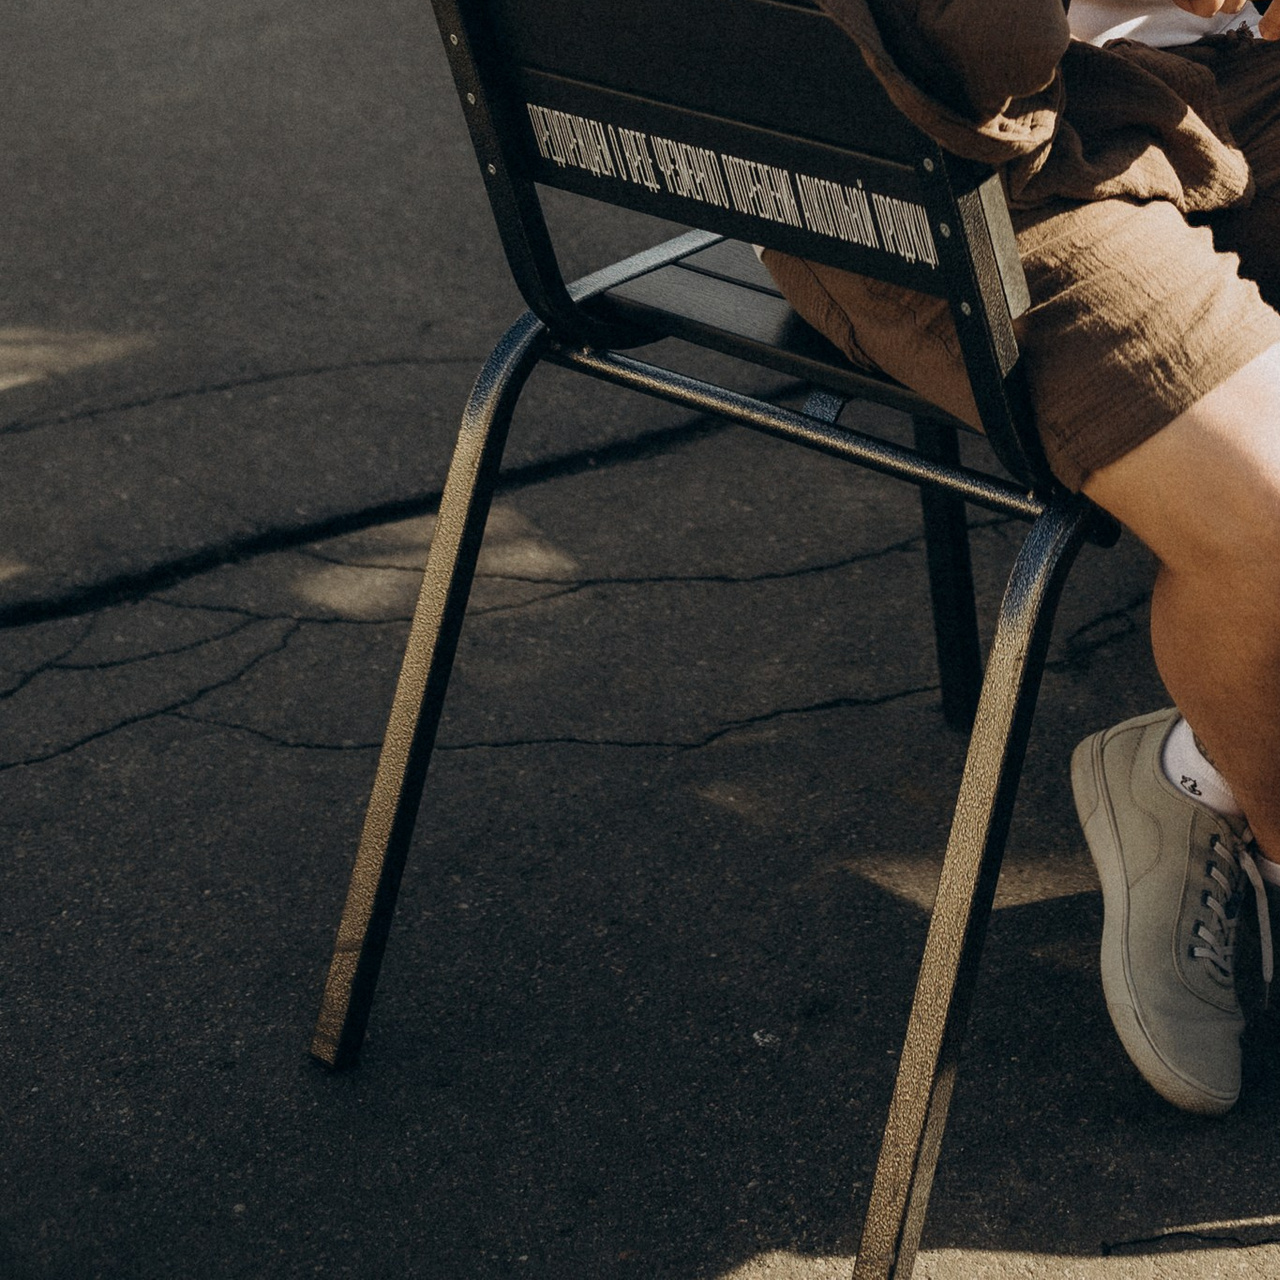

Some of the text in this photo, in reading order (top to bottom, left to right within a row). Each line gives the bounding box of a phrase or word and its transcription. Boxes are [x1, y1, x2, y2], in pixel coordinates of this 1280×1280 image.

[526, 102, 617, 178] ПРЕДУПРЕЖДАЕМ
[607, 123, 628, 182] О
[618, 126, 661, 193] ВРЕДЕ
[650, 135, 730, 210] ЧРЕЗМЕРНОГО
[720, 153, 803, 229] ПОТРЕБЛЕНИЯ
[795, 173, 880, 250] АЛКОГОЛЬНОЙ
